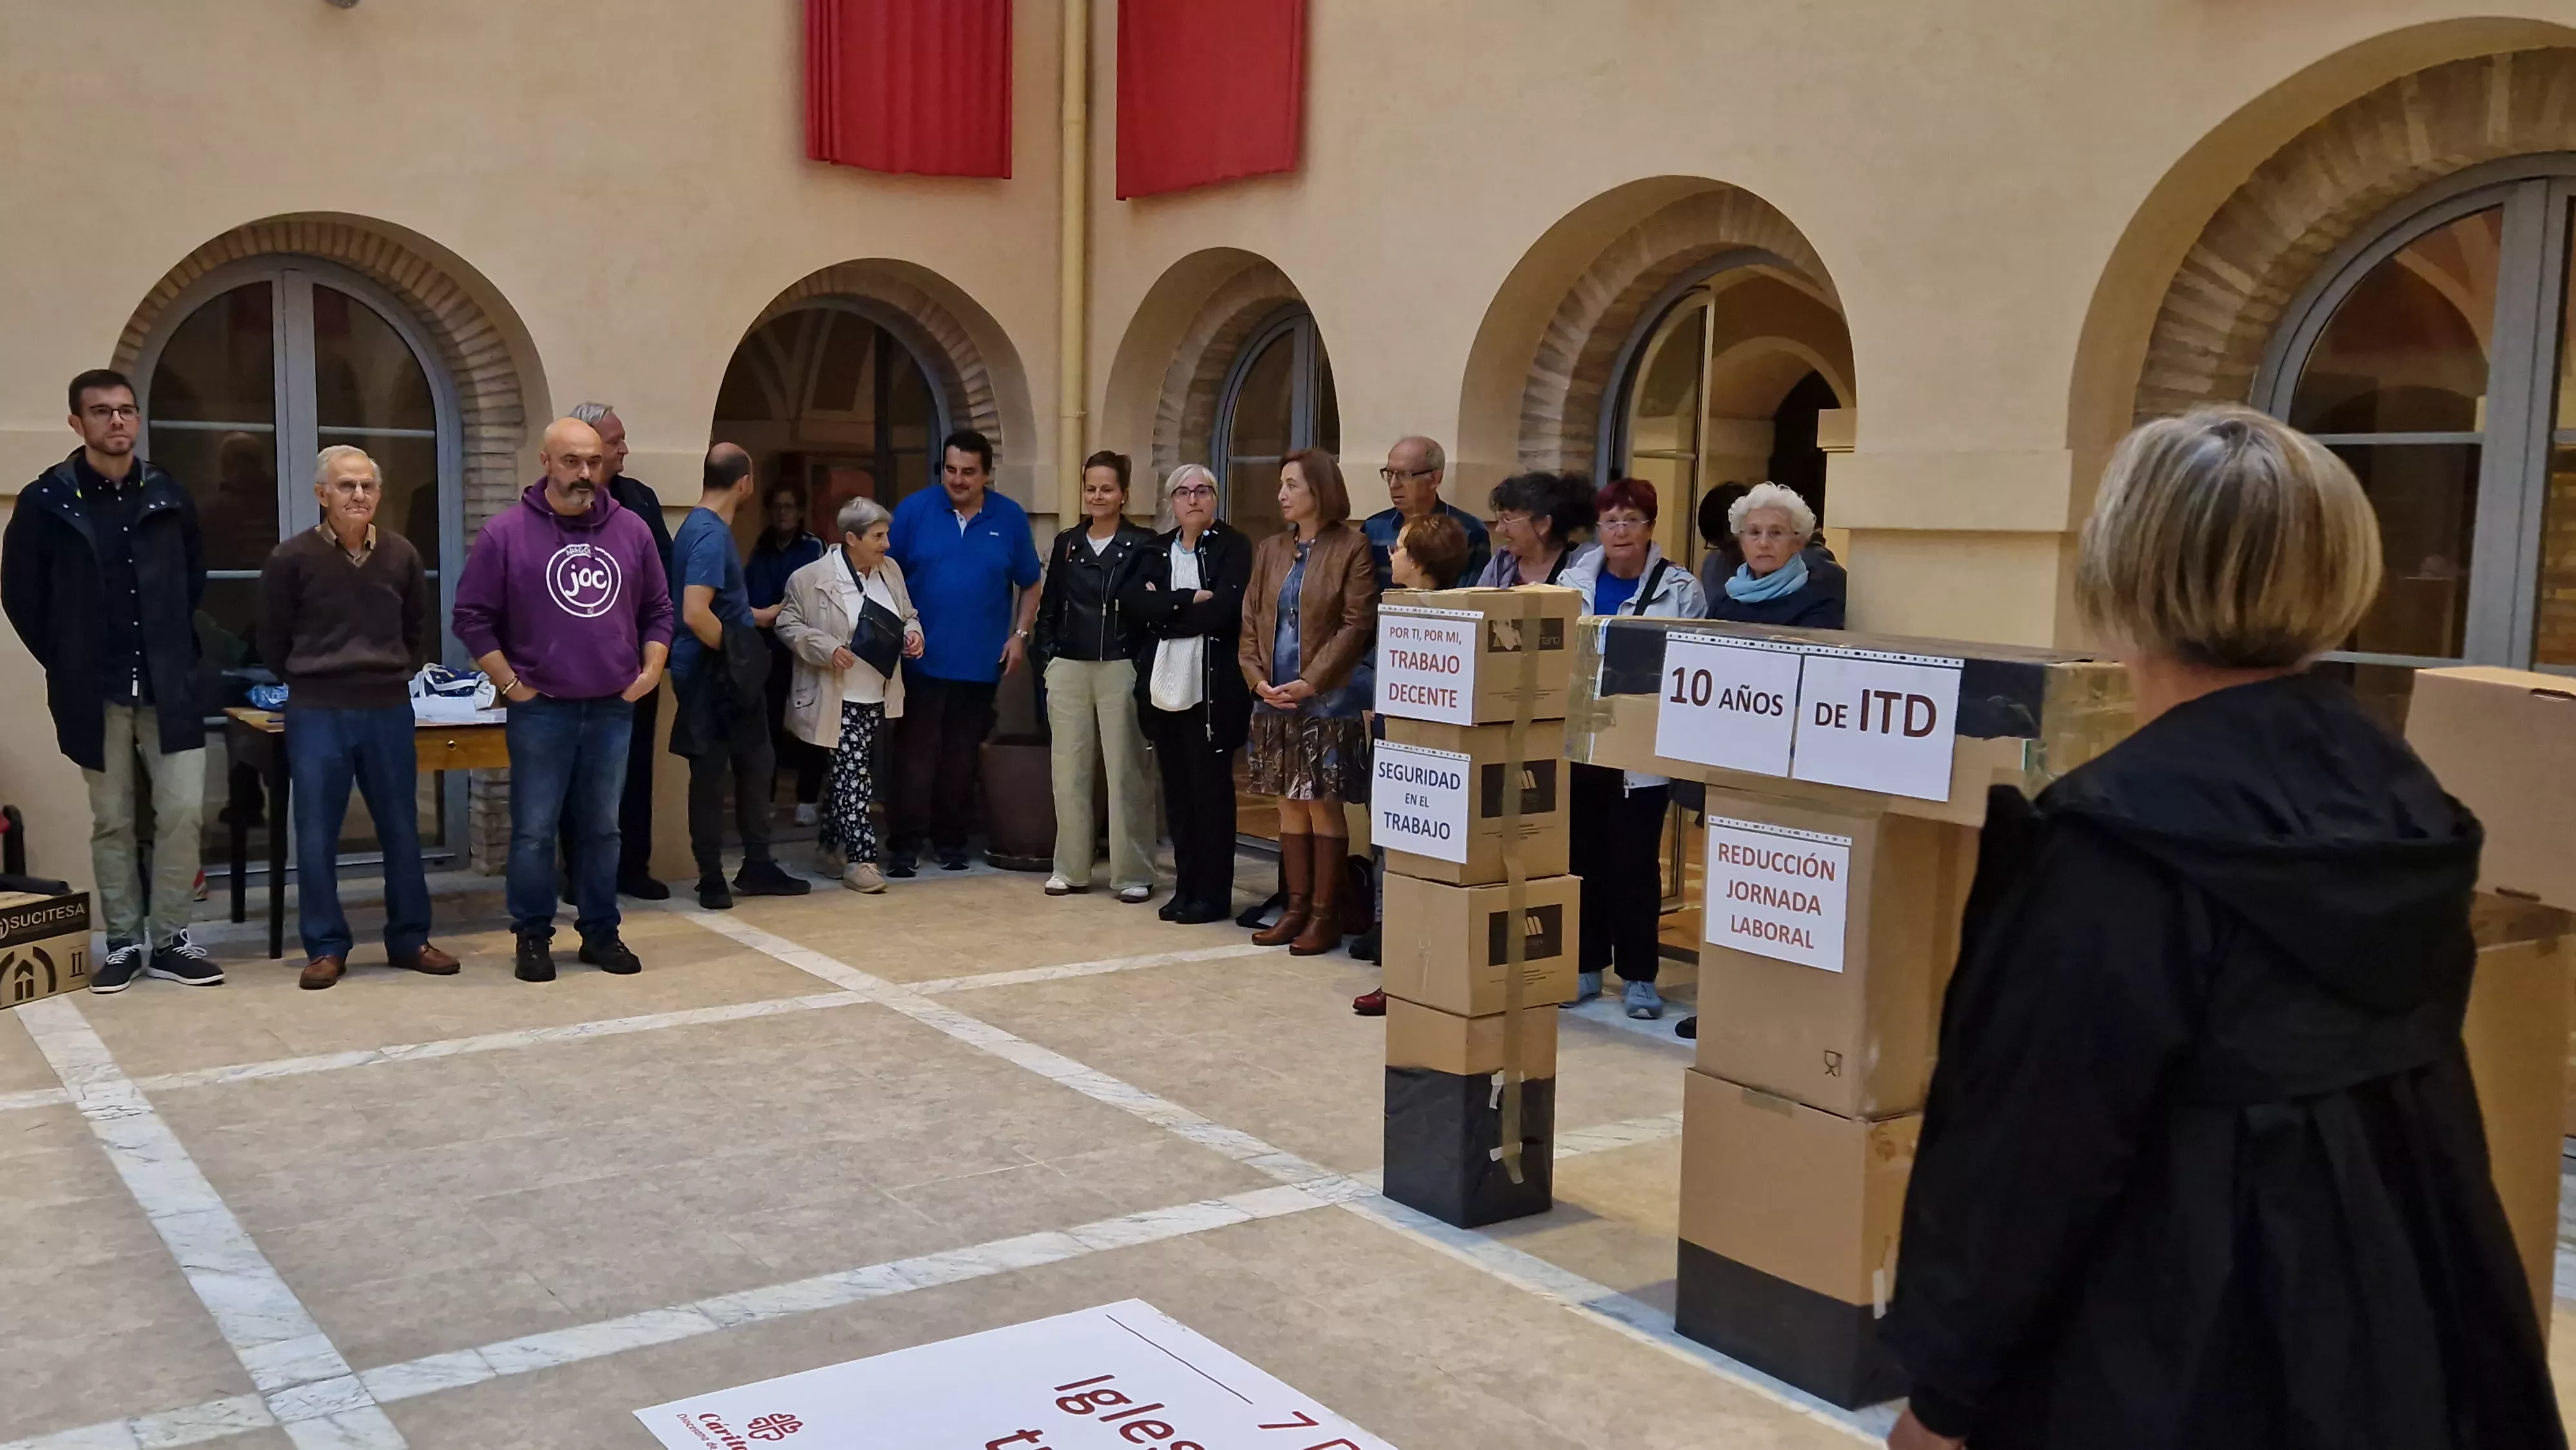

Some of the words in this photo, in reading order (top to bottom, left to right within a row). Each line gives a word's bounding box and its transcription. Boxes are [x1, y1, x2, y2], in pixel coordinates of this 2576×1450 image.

[564, 564, 607, 596] joc
[1390, 626, 1409, 639] POR
[1411, 628, 1422, 642] TI,
[1424, 629, 1443, 642] POR
[1445, 631, 1462, 646] MI,
[1389, 649, 1460, 674] TRABAJO
[1388, 682, 1457, 709] DECENTE
[1670, 666, 1712, 707] 10
[1718, 684, 1783, 717] AÑOS
[1814, 702, 1848, 729] DE
[1859, 688, 1937, 738] ITD
[1378, 761, 1461, 791] SEGURIDAD
[1405, 793, 1417, 805] EN
[1419, 795, 1430, 808] EL
[1383, 811, 1450, 840] TRABAJO
[1718, 842, 1836, 881] REDUCCIÓN
[1726, 879, 1823, 916] JORNADA
[10, 903, 85, 928] SUCITESA
[1730, 914, 1815, 950] LABORAL
[1257, 1411, 1320, 1429] 7
